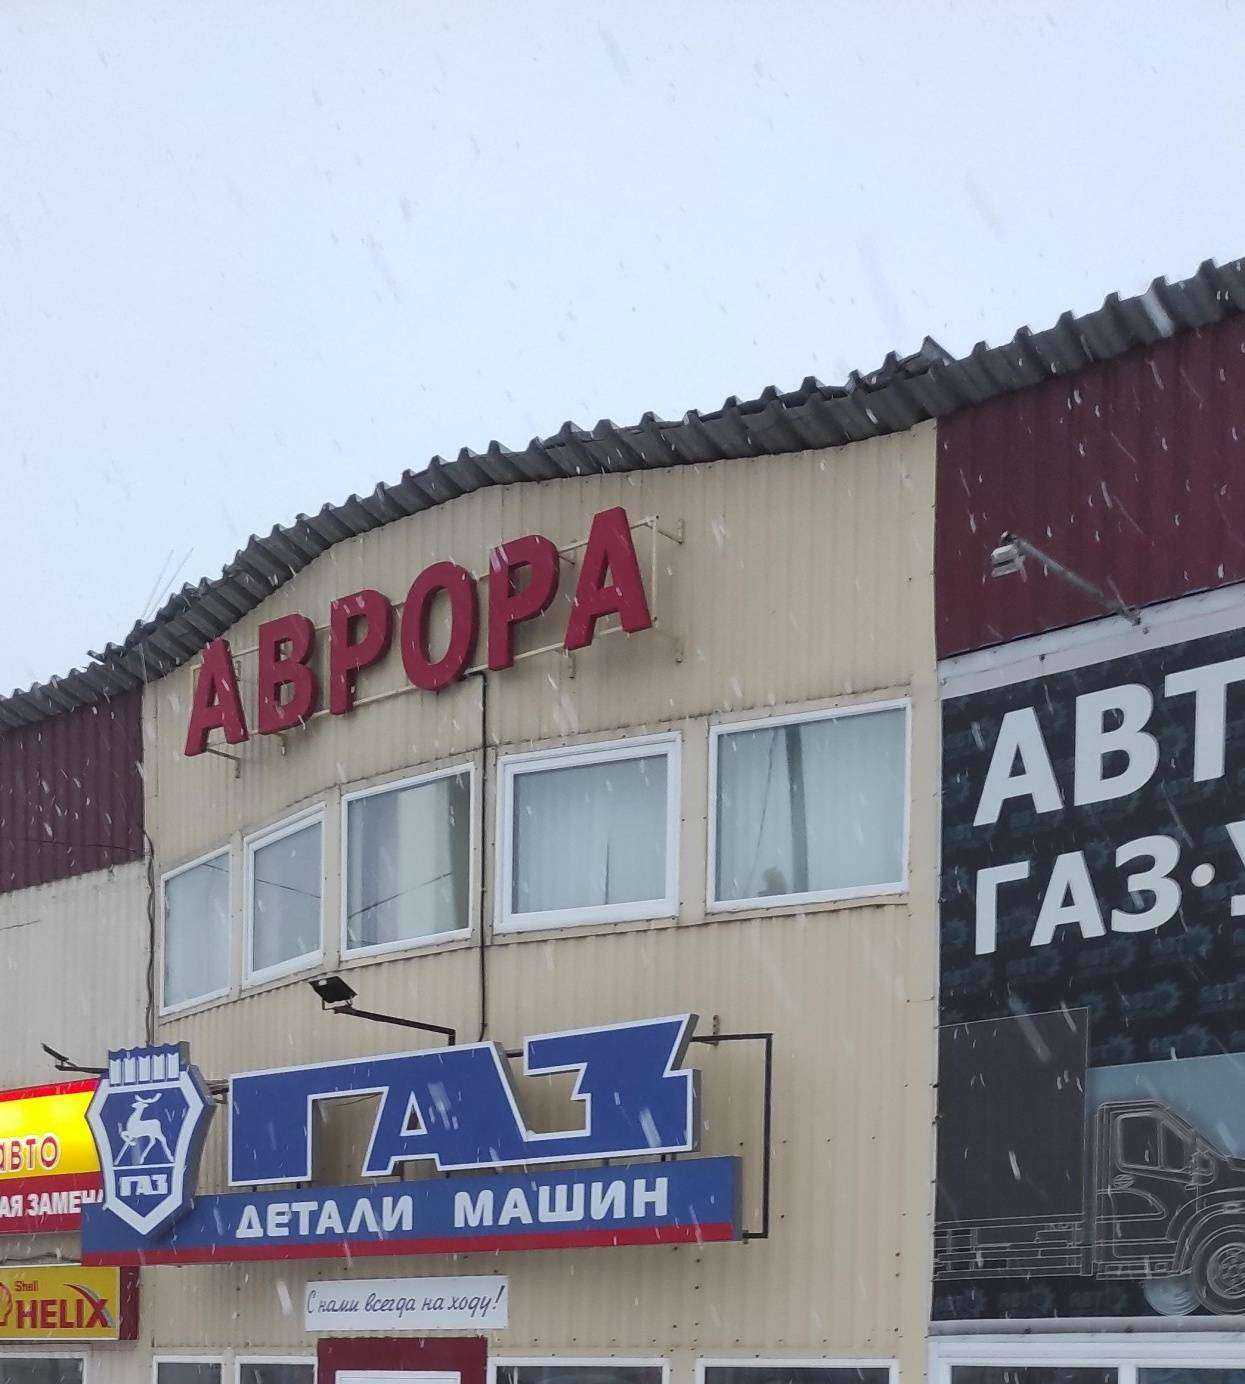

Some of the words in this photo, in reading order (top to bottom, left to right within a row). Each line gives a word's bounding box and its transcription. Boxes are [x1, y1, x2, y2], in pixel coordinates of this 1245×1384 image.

[184, 506, 652, 757] АВРОРА
[973, 656, 1245, 827] АВТ
[228, 1013, 701, 1187] ГАЗ
[118, 1174, 169, 1197] ГАЗ
[236, 1195, 414, 1239] ДЕТАЛИ
[453, 1176, 670, 1228] МАШИН
[14, 1280, 39, 1292] Shell
[307, 1289, 317, 1314] С
[318, 1299, 360, 1313] нами
[364, 1292, 416, 1318] всегда
[421, 1298, 444, 1311] на
[447, 1285, 506, 1318] ходу!
[15, 1298, 112, 1329] HELIX
